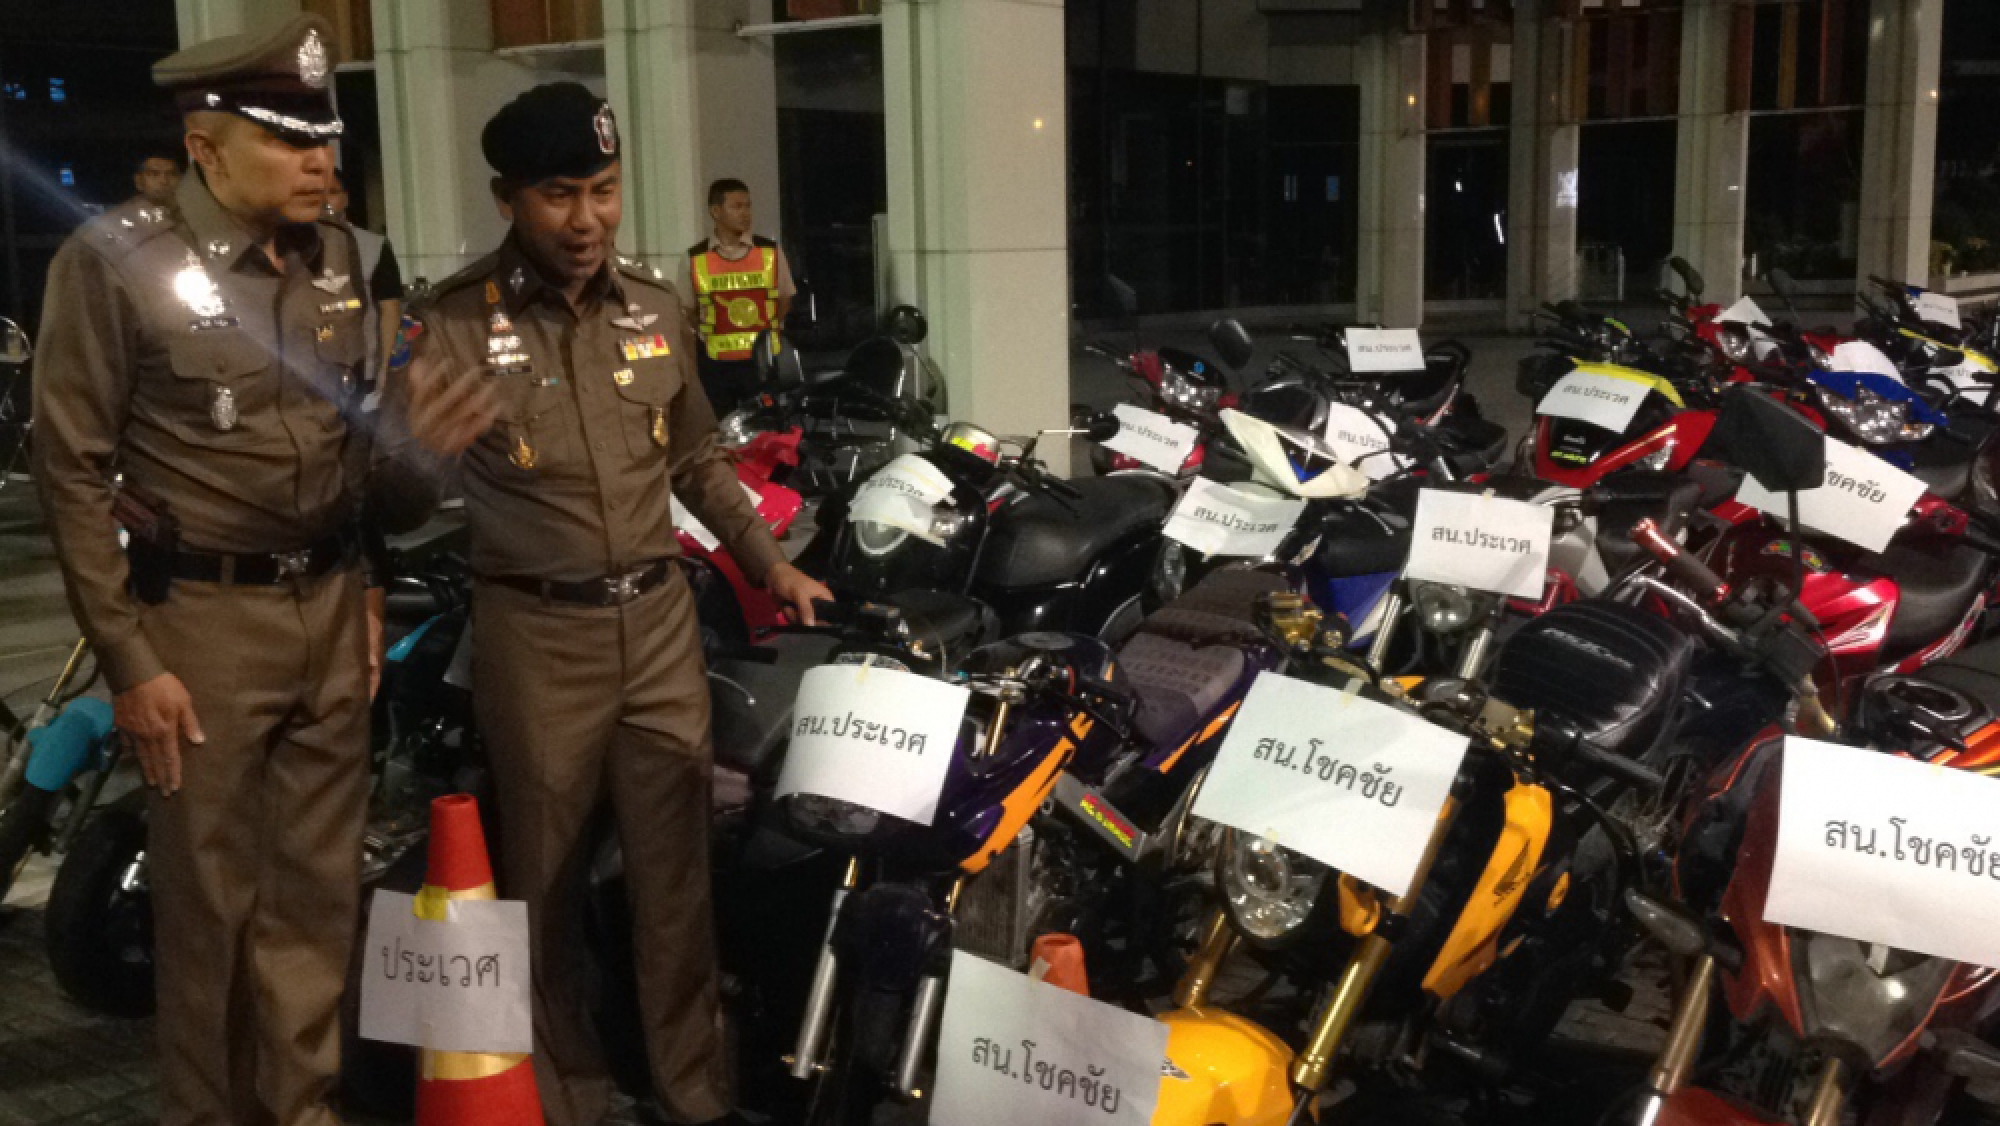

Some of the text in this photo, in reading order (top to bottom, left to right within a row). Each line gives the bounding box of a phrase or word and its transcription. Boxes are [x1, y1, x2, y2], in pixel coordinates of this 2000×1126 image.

[1563, 385, 1629, 404] สน.ประเวศ
[1193, 502, 1279, 536] สน.ประเวศ
[1430, 527, 1532, 555] สน.ประเวศ
[795, 711, 928, 756] สน.ประเวศ
[1252, 734, 1403, 808] สน.โชคชัย
[382, 938, 501, 988] ประเวศ
[970, 1036, 1120, 1114] สน.โชคชัย
